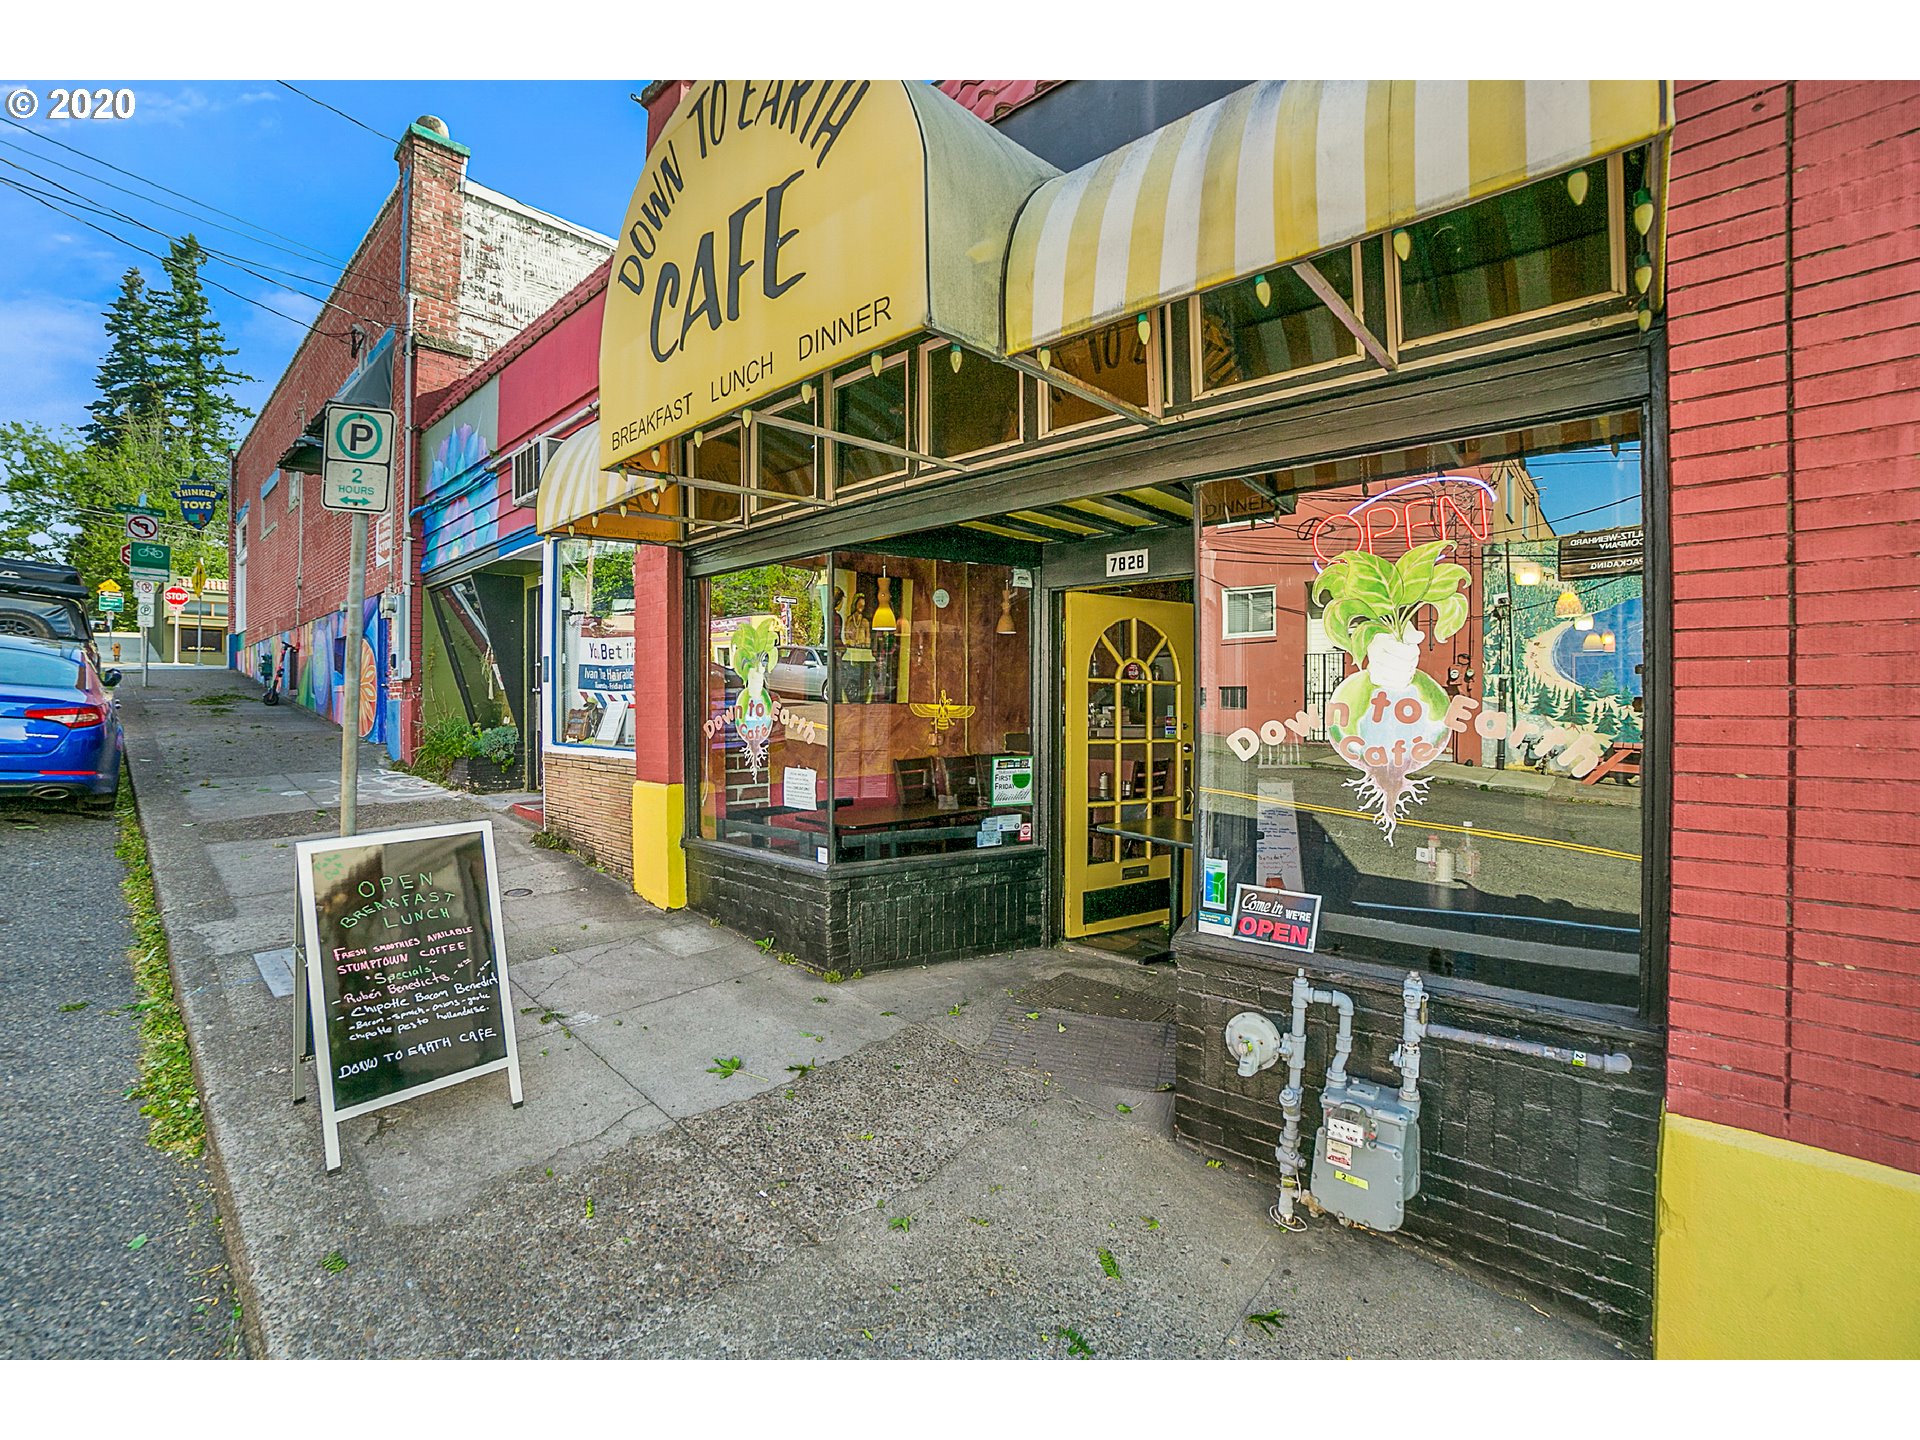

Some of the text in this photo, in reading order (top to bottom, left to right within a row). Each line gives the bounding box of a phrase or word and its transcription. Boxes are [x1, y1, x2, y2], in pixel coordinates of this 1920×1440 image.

[618, 80, 870, 295] DOWN TO EARTH
[650, 170, 807, 362] CAFE
[611, 296, 892, 451] BREAKFAST LUNCH DINNER
[350, 423, 373, 451] P
[352, 468, 363, 484] 2
[175, 488, 217, 498] THINKER
[338, 485, 375, 496] HOURS
[182, 501, 212, 510] TOYS
[1313, 488, 1488, 564] OPEN
[1110, 554, 1144, 572] 7828
[166, 592, 188, 601] STOP
[601, 643, 622, 660] Bet
[584, 667, 598, 679] Ivan
[703, 699, 816, 744] Down to Earth
[738, 723, 769, 740] Café
[1226, 691, 1600, 778] Down to Earth
[1338, 735, 1439, 768] Café
[358, 872, 433, 898] OPEN
[340, 891, 456, 929] BREAKFAST
[383, 907, 450, 929] LUNCH
[1242, 893, 1312, 923] Come in WE'RE
[372, 938, 421, 953] SMOOTHIES
[427, 926, 474, 942] AVAILABLE
[1238, 916, 1309, 946] OPEN
[337, 941, 467, 975] STUMPTOWN COFFEE
[374, 965, 432, 985] Specials
[351, 998, 410, 1018] Chipotle
[397, 1018, 429, 1034] pesto
[383, 1050, 403, 1062] TO
[407, 1037, 452, 1056] EARTH
[459, 1028, 497, 1042] CAFE
